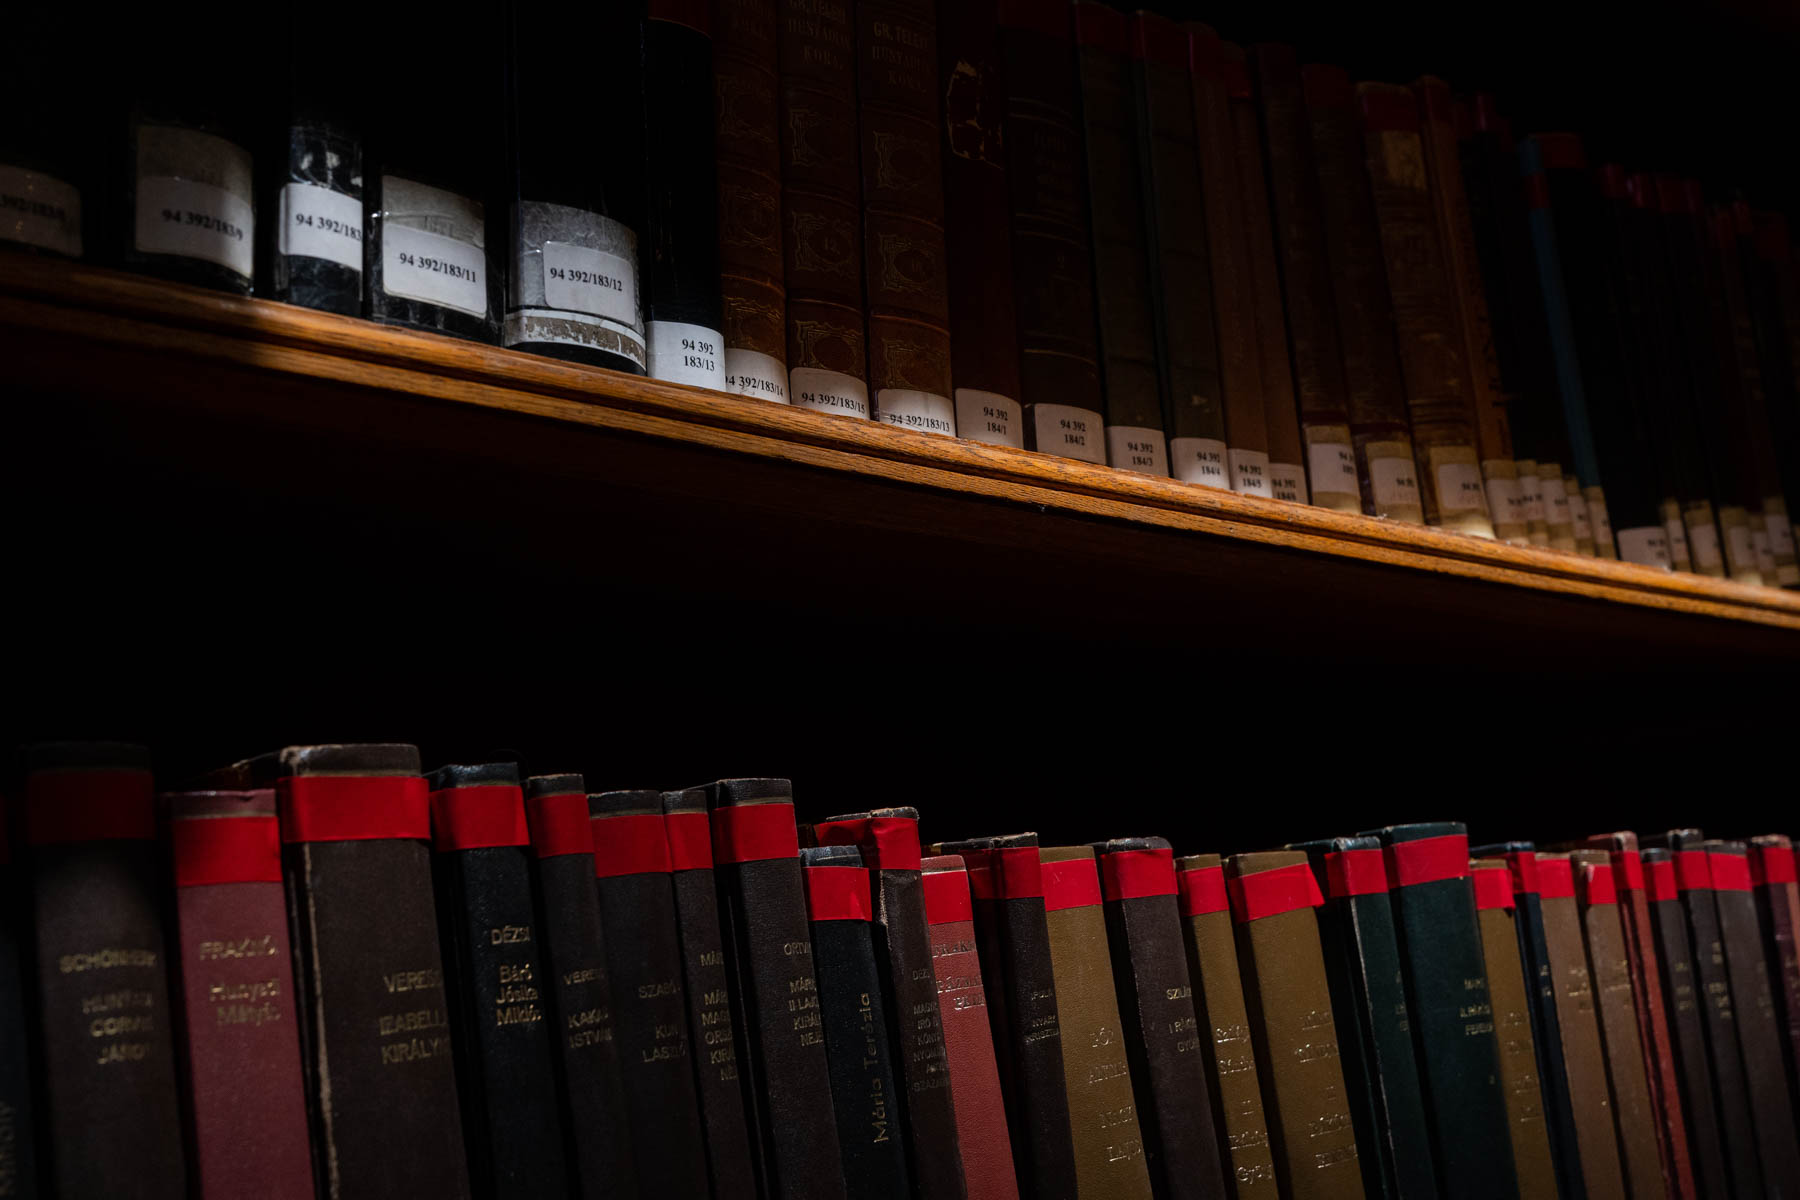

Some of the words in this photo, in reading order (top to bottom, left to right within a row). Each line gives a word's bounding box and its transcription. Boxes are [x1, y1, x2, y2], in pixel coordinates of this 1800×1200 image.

[162, 209, 181, 223] 94
[296, 213, 313, 227] 94
[399, 252, 415, 267] 94
[418, 256, 477, 283] 392/183/11
[549, 267, 565, 280] 94
[568, 271, 623, 292] 392/183/12
[682, 338, 696, 351] 94
[698, 342, 714, 356] 392
[683, 354, 716, 372] 183/13
[725, 374, 735, 387] 4
[739, 375, 784, 397] 392/183/14
[801, 391, 815, 404] 94
[818, 394, 866, 415] 392/183/15
[890, 413, 903, 426] 94
[983, 406, 994, 417] 94
[996, 408, 1008, 422] 392
[986, 421, 1008, 436] 184/1
[1060, 418, 1072, 430] 94
[1073, 421, 1086, 433] 392
[1064, 433, 1086, 447] 184/2
[1127, 441, 1139, 453] 94
[1140, 443, 1154, 455] 392
[1197, 451, 1207, 462] 94
[1238, 464, 1249, 474] 94
[858, 992, 879, 1071] Terézia
[870, 1078, 890, 1144] Mária
